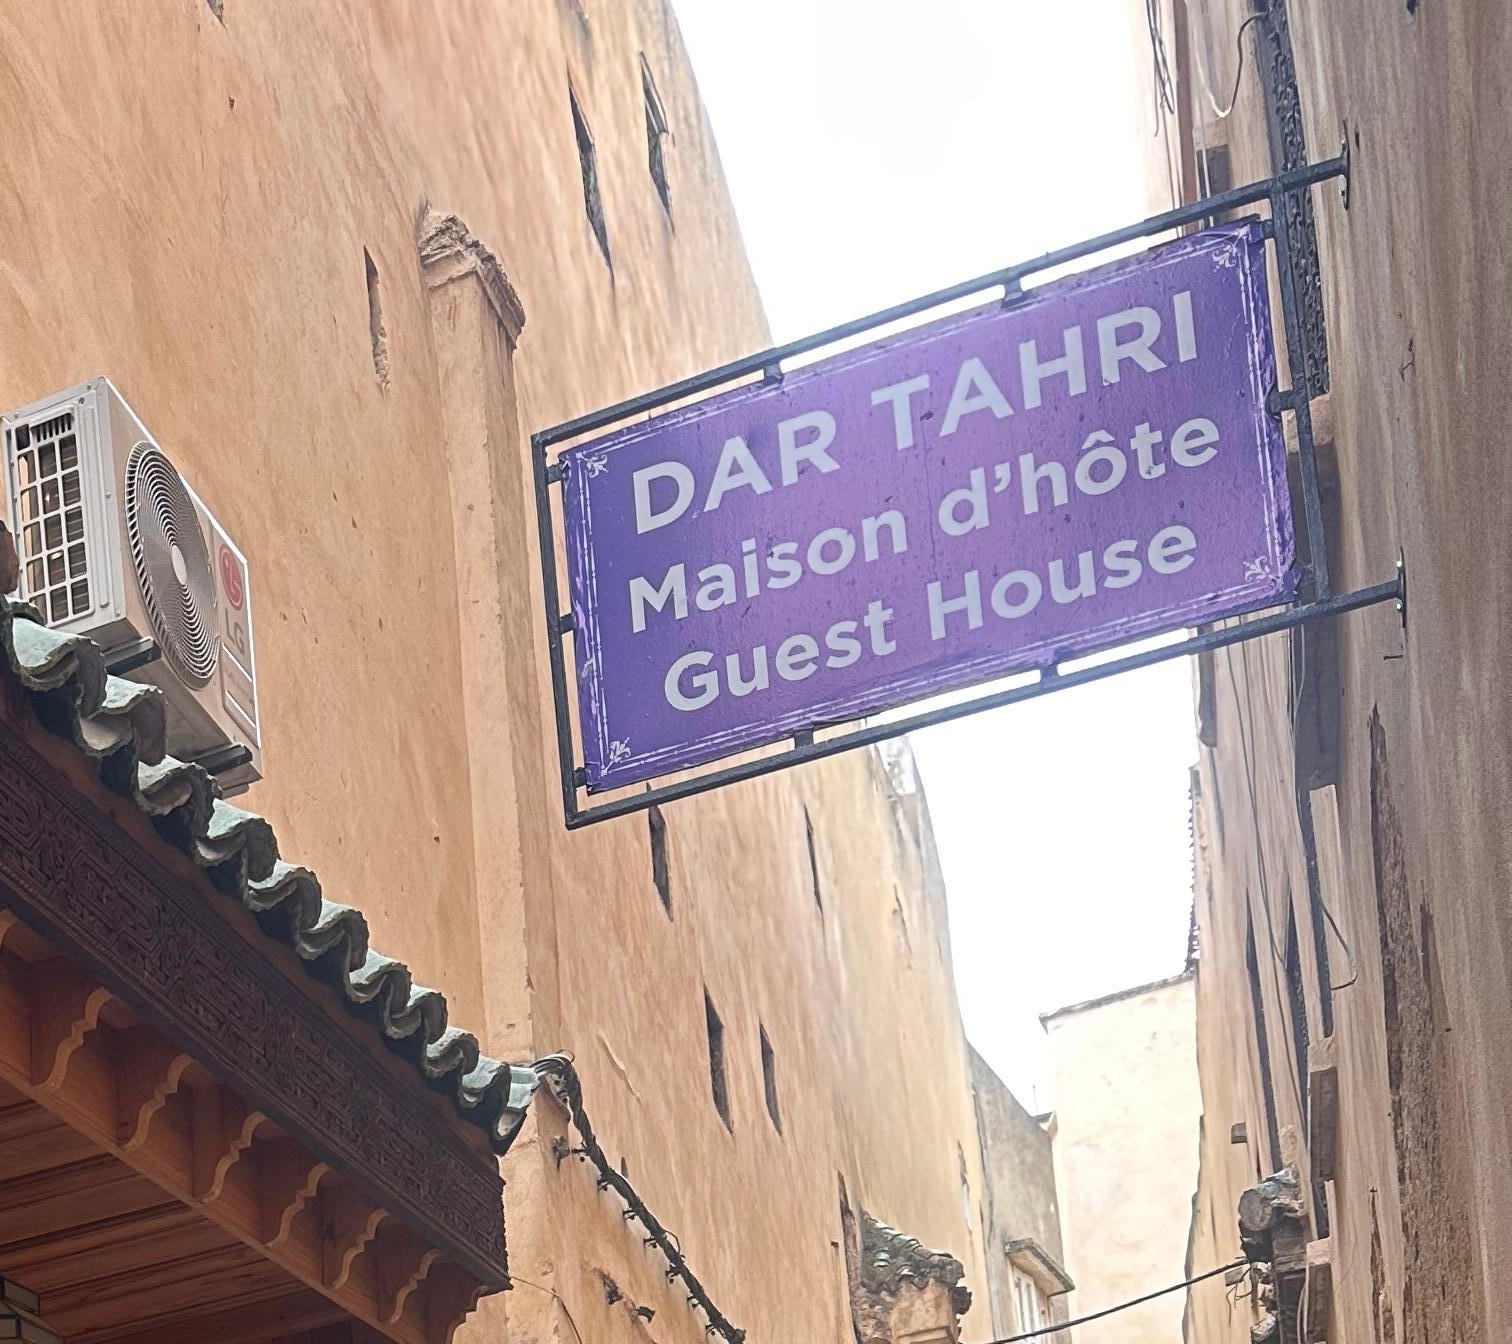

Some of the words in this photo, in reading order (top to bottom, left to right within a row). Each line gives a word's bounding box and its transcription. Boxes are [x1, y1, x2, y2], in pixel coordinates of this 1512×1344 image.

[631, 410, 841, 535] DAR
[869, 290, 1198, 452] TAHRI
[224, 607, 246, 656] LG
[628, 506, 909, 634] Maison
[663, 599, 899, 713] Guest
[926, 522, 1198, 642] House
